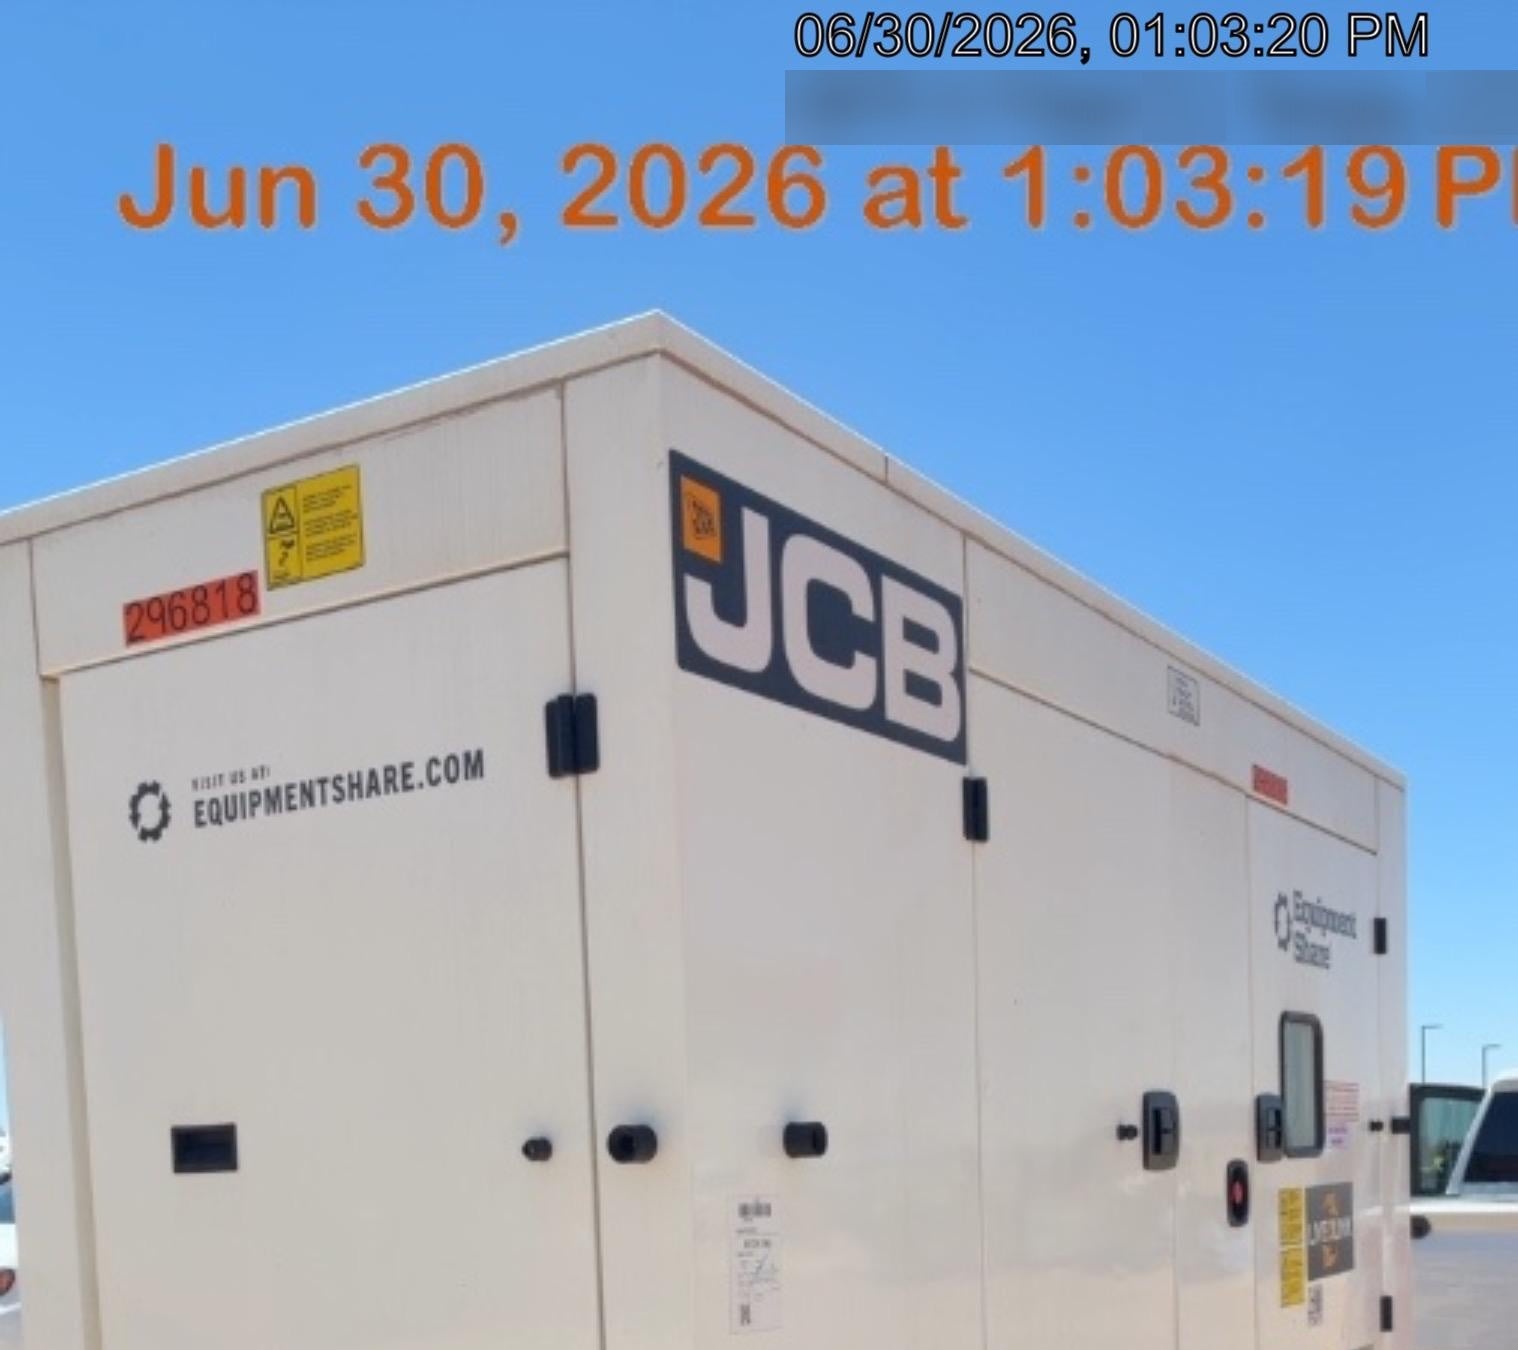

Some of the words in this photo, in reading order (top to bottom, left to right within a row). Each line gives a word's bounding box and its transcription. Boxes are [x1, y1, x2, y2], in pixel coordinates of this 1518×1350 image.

[125, 572, 258, 644] 296818
[684, 505, 961, 742] JCB
[194, 749, 484, 828] EQUIPMENTSHARE.COM
